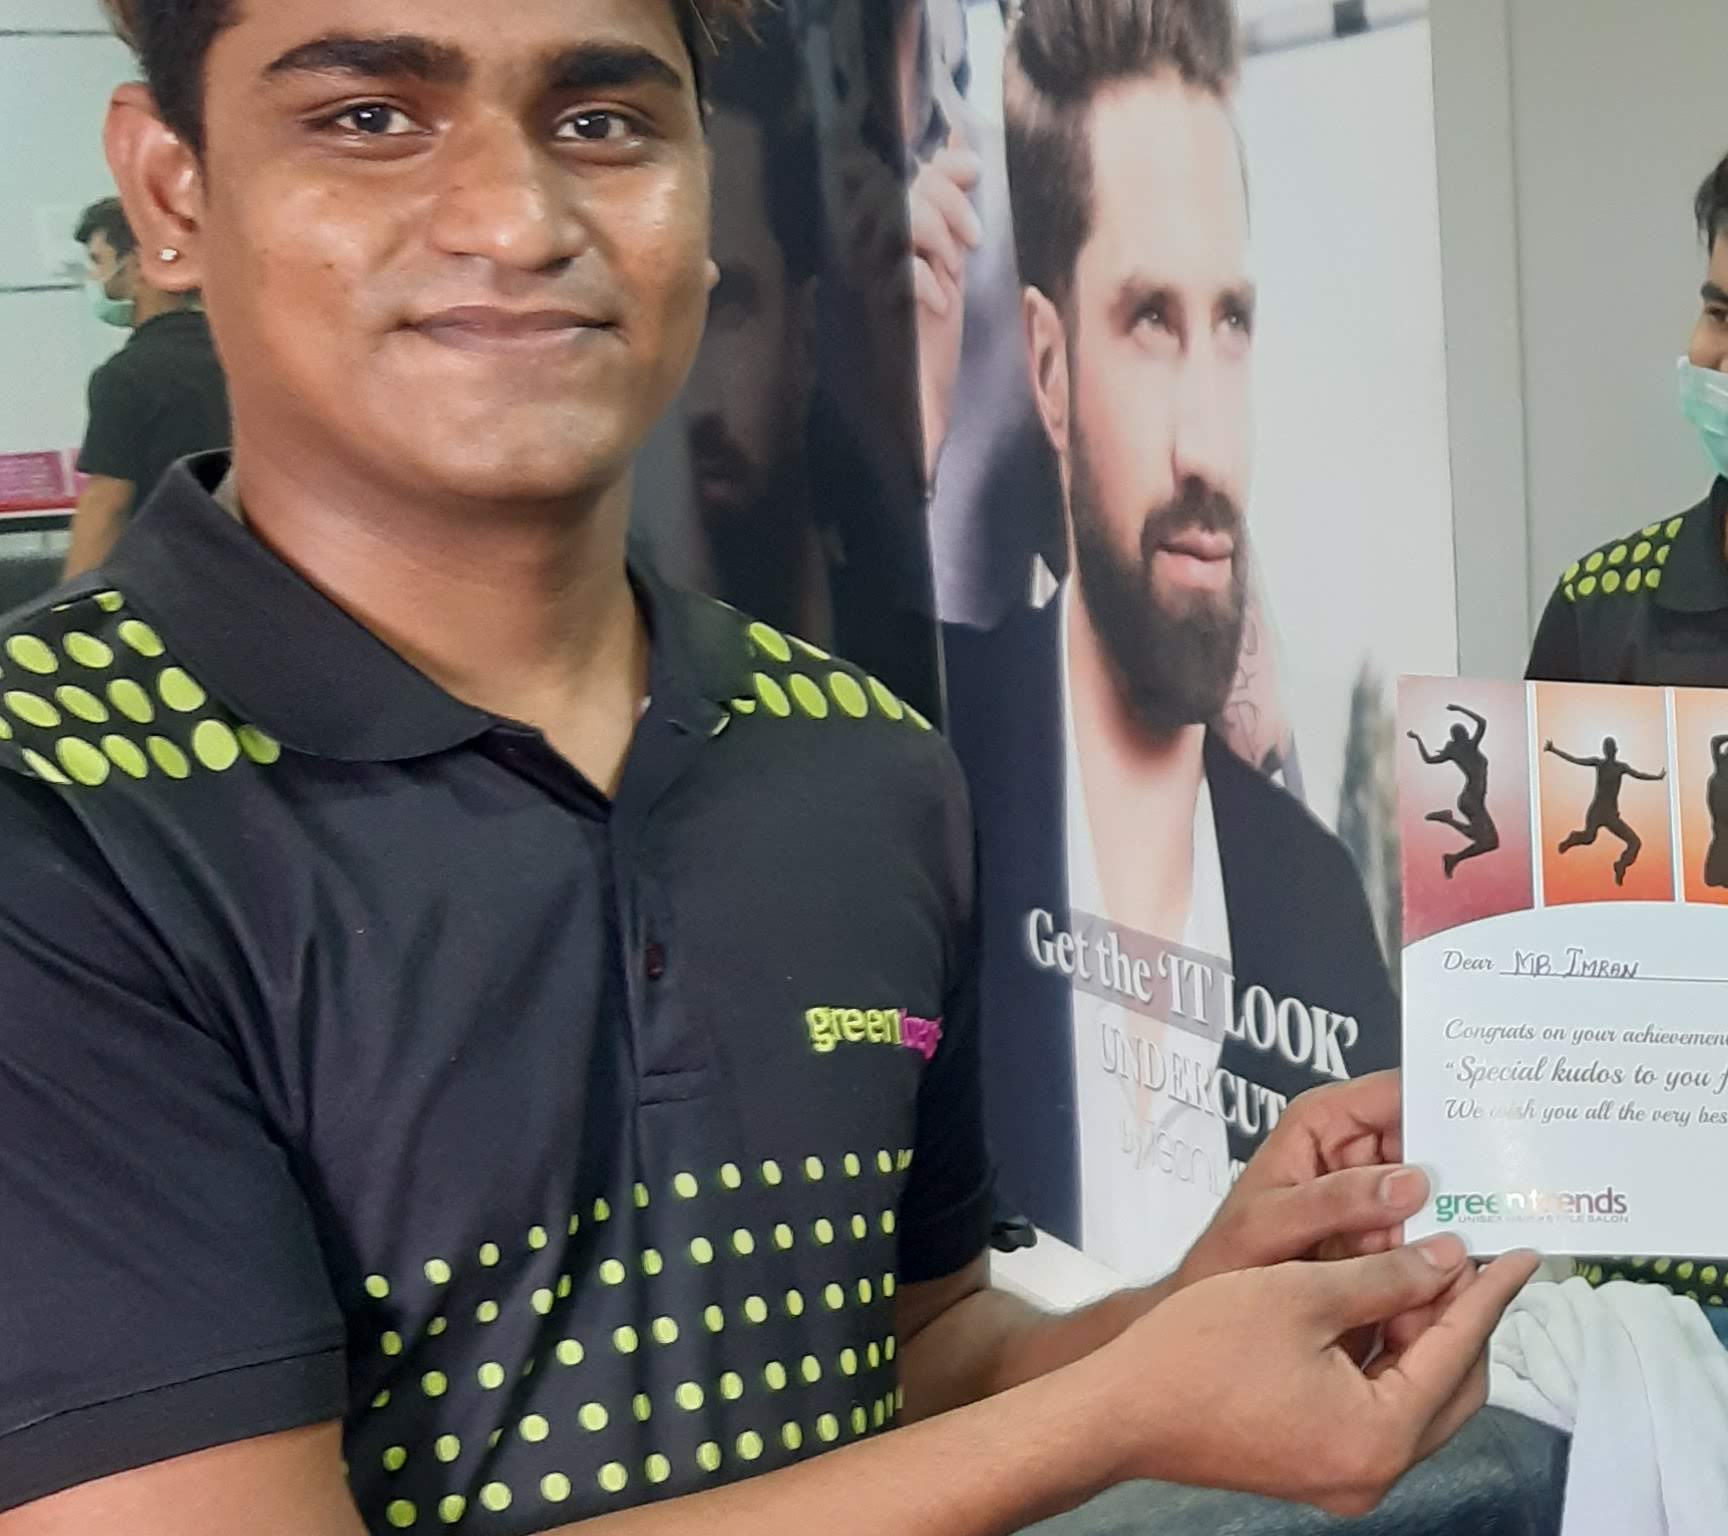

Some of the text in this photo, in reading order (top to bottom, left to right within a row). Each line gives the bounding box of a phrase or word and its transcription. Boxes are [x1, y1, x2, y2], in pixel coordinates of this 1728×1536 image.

[1028, 908, 1090, 979] Get
[1096, 932, 1154, 1003] the
[1443, 950, 1494, 971] Dear
[1445, 1018, 1535, 1044] Congrats
[1542, 1027, 1566, 1040] on
[1571, 1027, 1617, 1045] your
[1551, 1057, 1625, 1086] kudos
[1633, 1062, 1657, 1085] to
[1663, 1072, 1711, 1092] you
[1540, 1106, 1579, 1124] you
[1584, 1099, 1614, 1121] all
[1618, 1100, 1646, 1122] the
[1651, 1111, 1692, 1127] very
